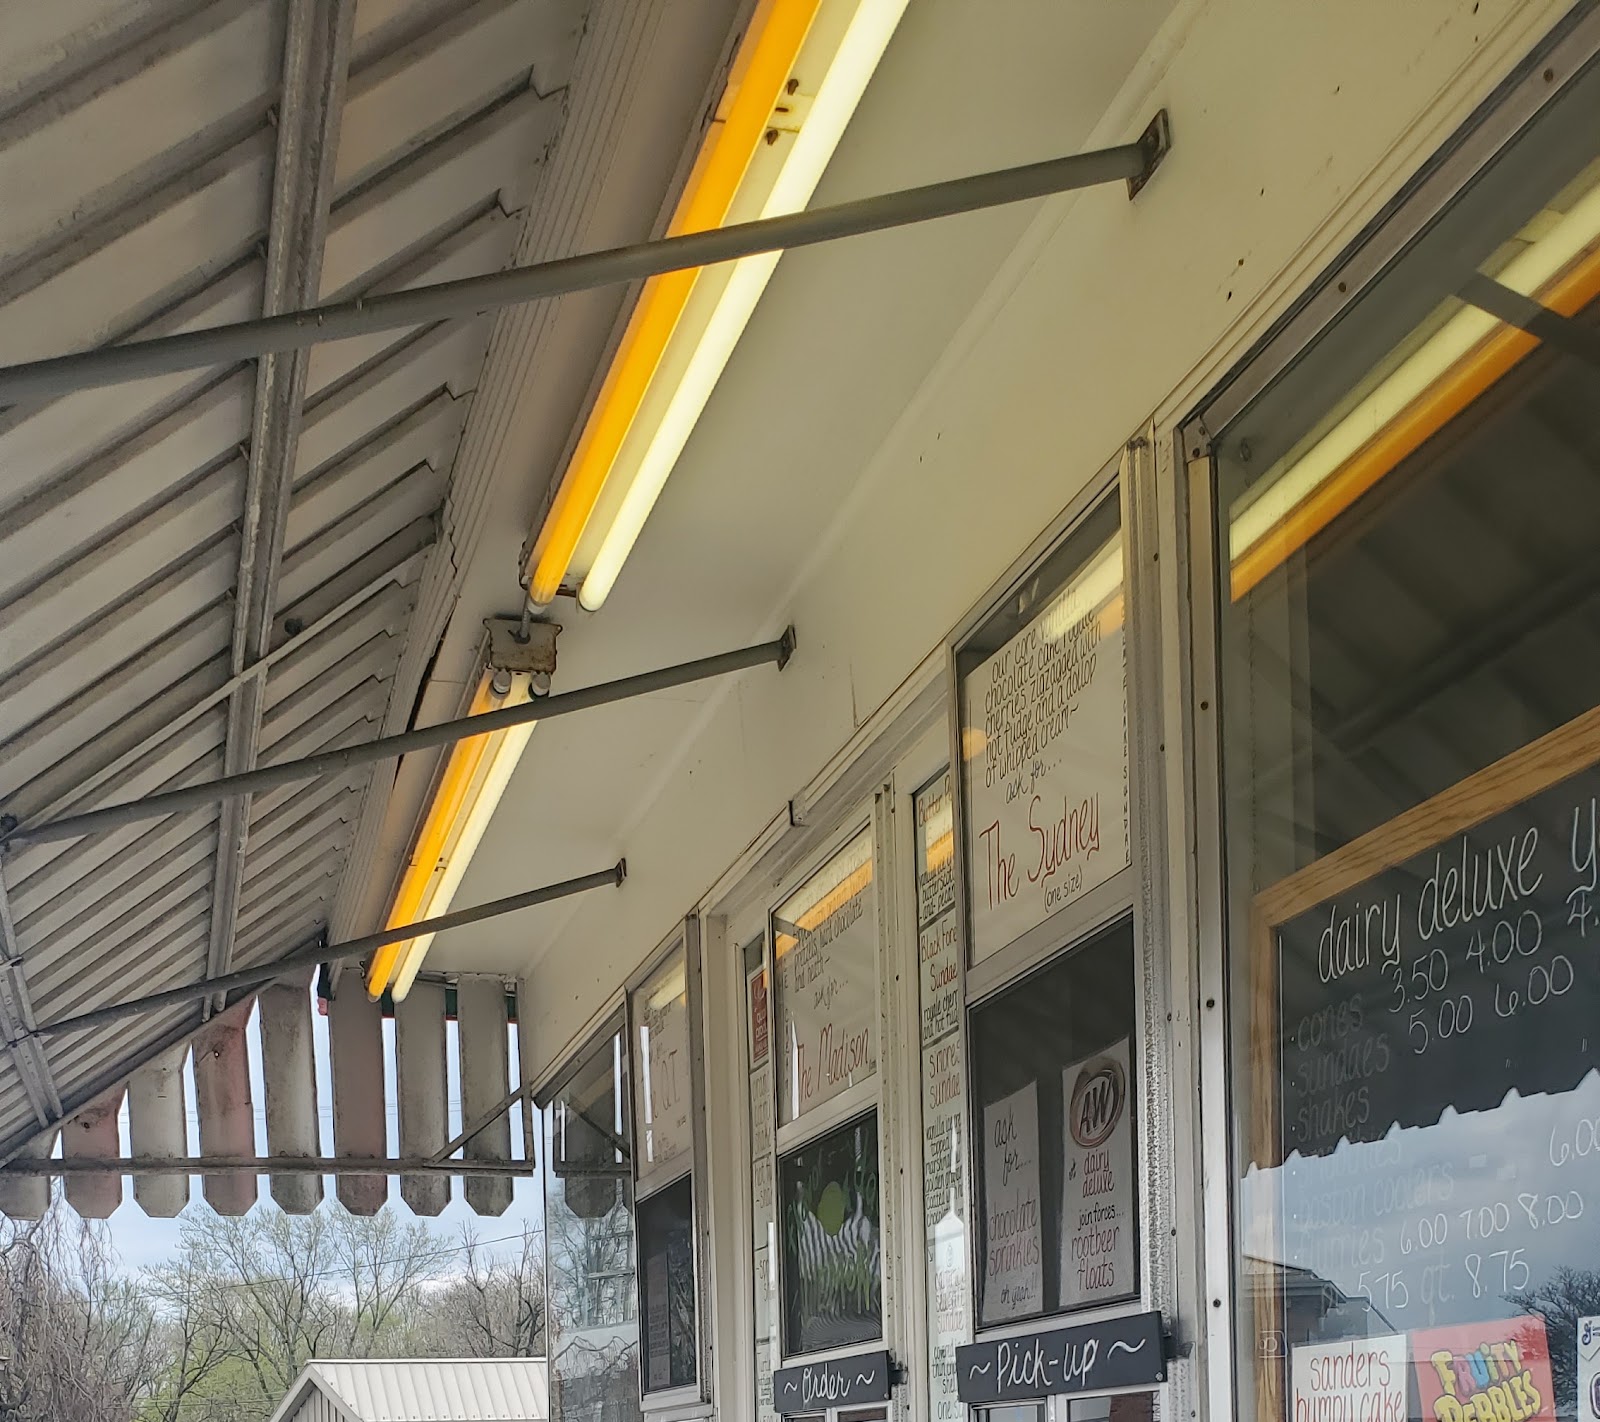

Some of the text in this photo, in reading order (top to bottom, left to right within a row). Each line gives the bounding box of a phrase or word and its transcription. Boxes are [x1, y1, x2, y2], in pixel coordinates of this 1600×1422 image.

[985, 653, 1036, 714] chocolate
[992, 650, 1011, 684] our
[979, 818, 1020, 911] The
[1027, 791, 1101, 890] Sydney
[1318, 892, 1401, 985] dairy
[1417, 825, 1544, 941] deluxe
[1297, 992, 1364, 1052] cones
[1388, 947, 1449, 1015] 3.50
[1465, 910, 1544, 974] 4.00
[1297, 954, 1575, 1099] sundaes 5.00 6.00
[797, 1043, 813, 1102] The
[818, 1022, 869, 1092] Madison
[994, 1105, 1018, 1148] ask
[1297, 1085, 1371, 1143] shakes
[1082, 1170, 1115, 1198] deluxe
[1083, 1149, 1110, 1176] dairy
[989, 1188, 1038, 1242] chocolate
[1399, 1213, 1449, 1256] 6.00
[1459, 1201, 1511, 1241] 7.00
[1517, 1190, 1584, 1231] 8.00
[989, 1235, 1040, 1282] sprinkles
[1076, 1255, 1115, 1291] floats
[1464, 1247, 1531, 1300] 8.75
[802, 1362, 851, 1404] Order
[996, 1337, 1101, 1395] Pick-up
[1310, 1343, 1393, 1393] sanders
